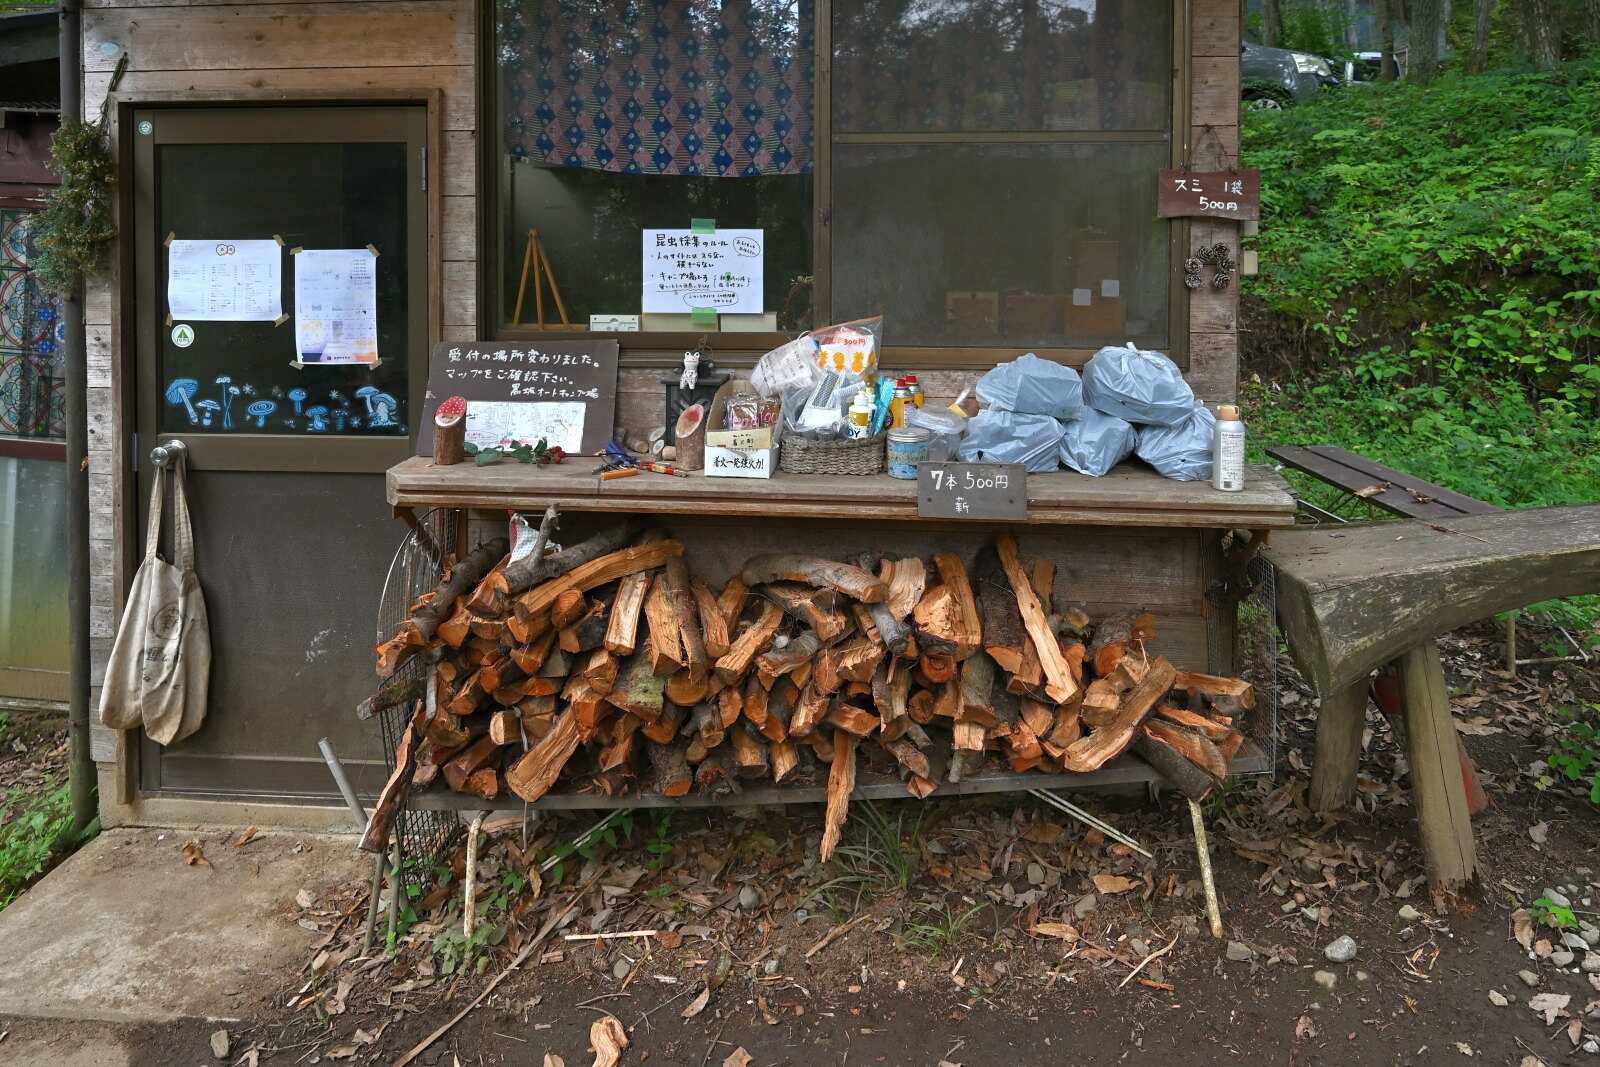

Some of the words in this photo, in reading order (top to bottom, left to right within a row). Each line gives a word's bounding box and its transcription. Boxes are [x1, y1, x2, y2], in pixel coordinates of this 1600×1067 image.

[1174, 179, 1203, 192] スミ
[1224, 179, 1244, 195] 1袋
[1199, 196, 1238, 211] 500円
[656, 233, 729, 248] 昆虫採集のルール
[448, 347, 600, 368] 受付の場所変わりました。
[445, 369, 574, 385] マップをご確認下さい。
[510, 383, 600, 400] 黒坂オートキャンプ場
[930, 470, 958, 491] 7本
[963, 471, 1009, 489] 500円
